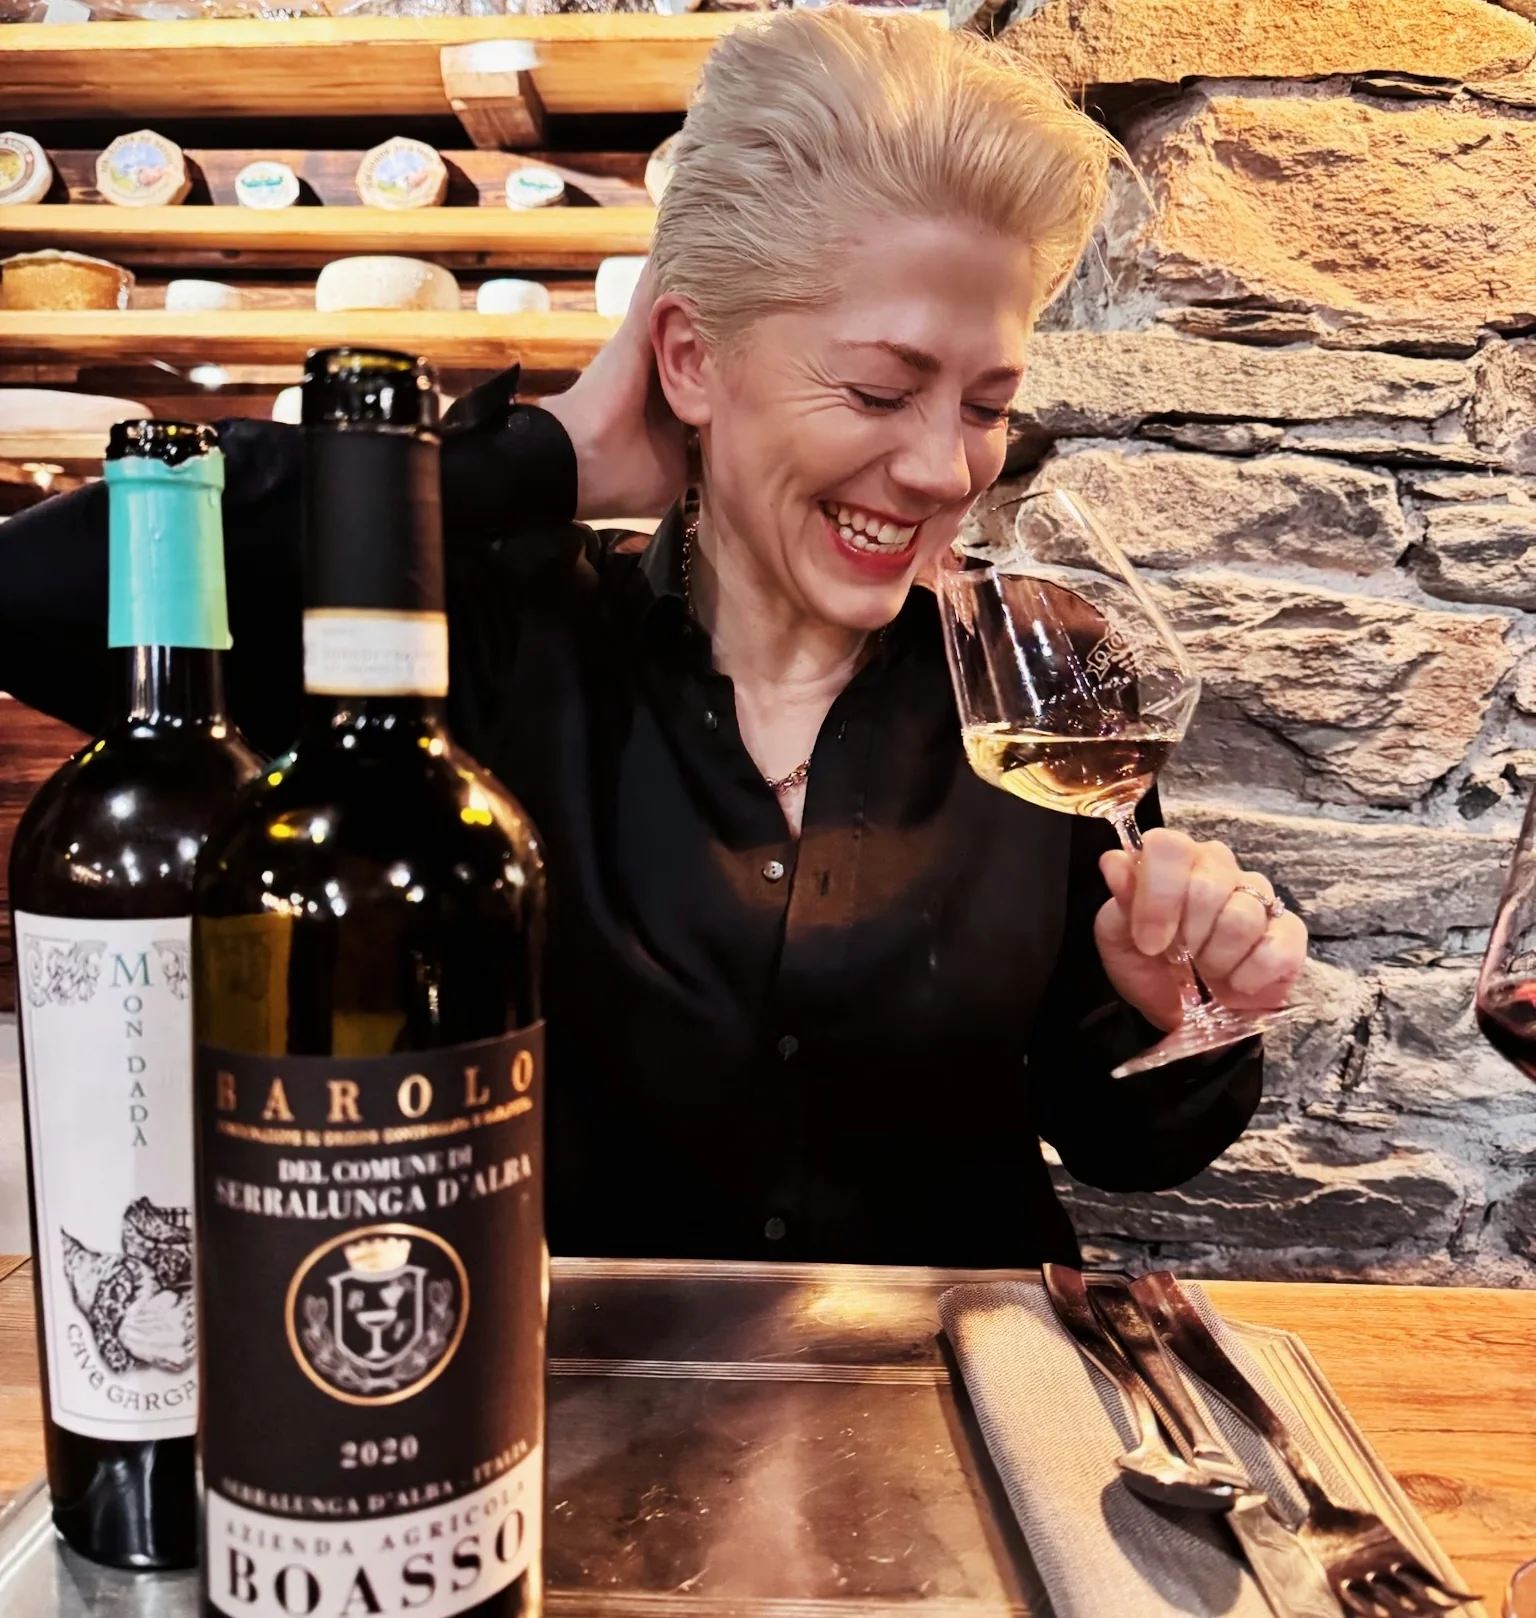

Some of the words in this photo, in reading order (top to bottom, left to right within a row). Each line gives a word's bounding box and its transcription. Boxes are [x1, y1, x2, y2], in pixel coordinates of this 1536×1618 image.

[216, 1050, 533, 1122] BAROLO
[278, 1157, 329, 1184] DEL
[331, 1153, 444, 1184] COMUNE
[216, 1177, 426, 1219] SERRALUNGA
[340, 1434, 419, 1469] 2020
[226, 1520, 355, 1556] AZIENDA
[380, 1480, 525, 1551] AGRICOLA
[228, 1508, 525, 1617] BOASSO
